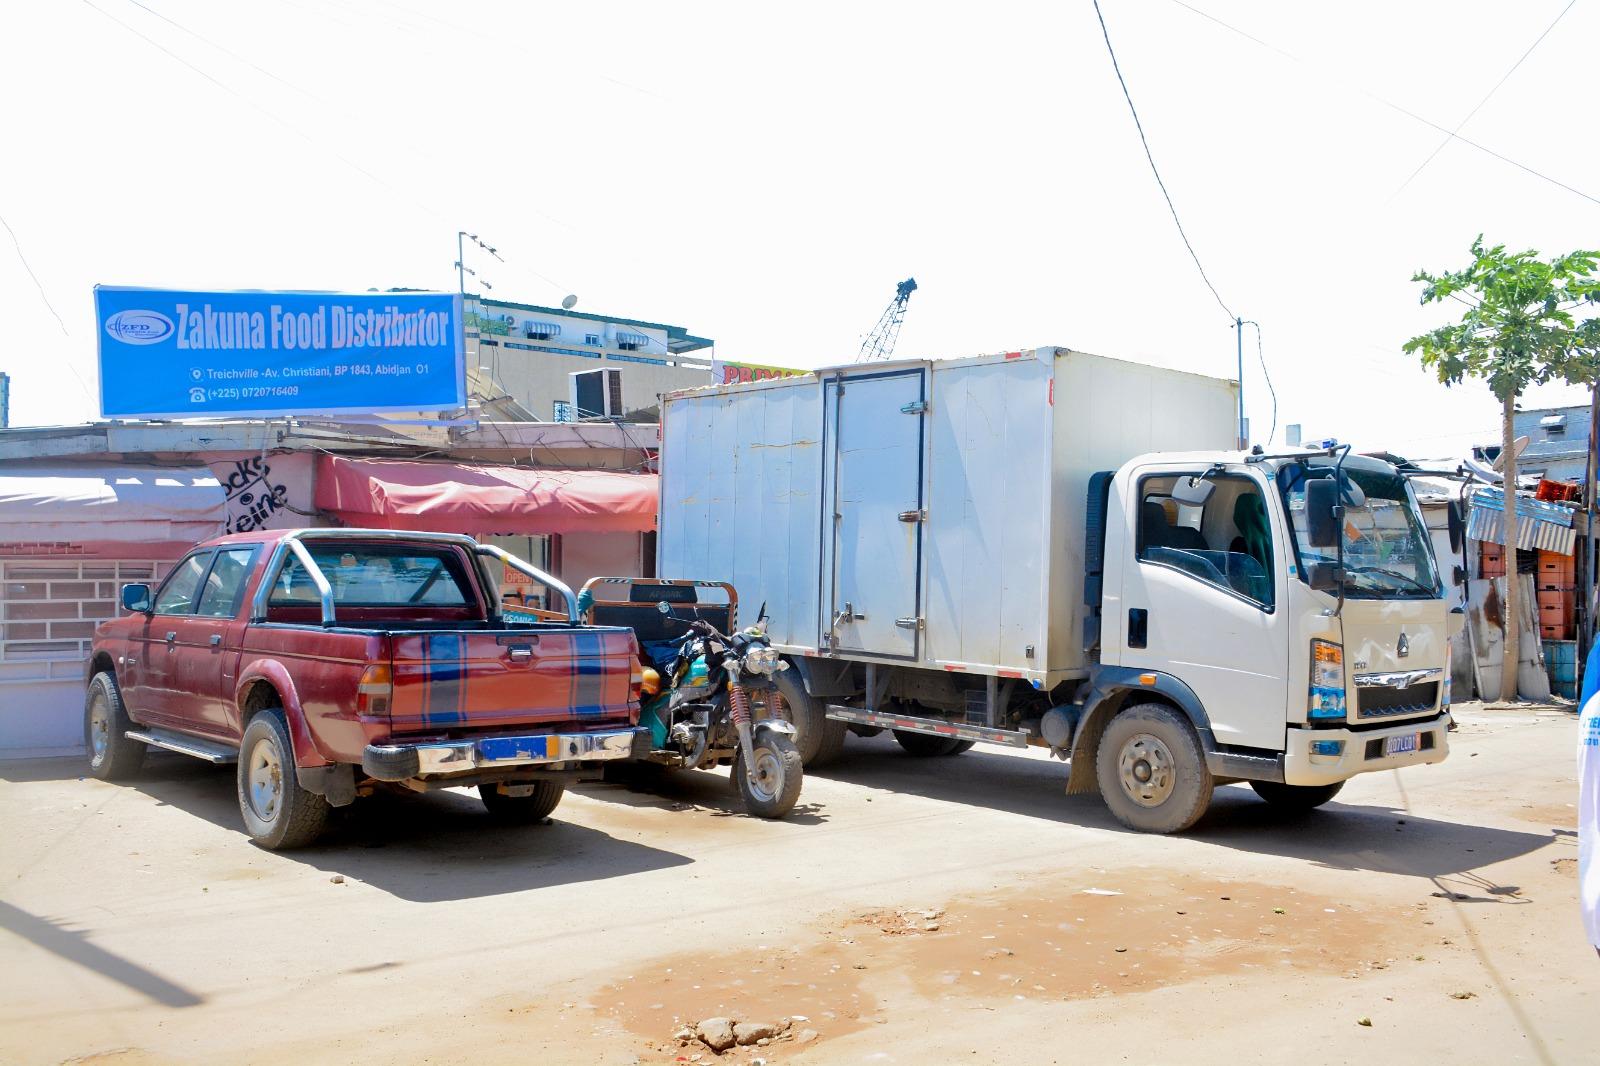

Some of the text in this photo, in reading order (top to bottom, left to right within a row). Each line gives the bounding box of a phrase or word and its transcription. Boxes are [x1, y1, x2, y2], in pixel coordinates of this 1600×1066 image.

[175, 303, 449, 350] Zakuna Food Distributor
[206, 368, 259, 380] Treichville
[282, 366, 332, 378] Christiani,
[334, 365, 348, 376] BP
[350, 364, 374, 376] 1843,
[375, 363, 411, 377] Abidjan
[208, 387, 240, 400] (+225)
[506, 573, 531, 583] OPEN
